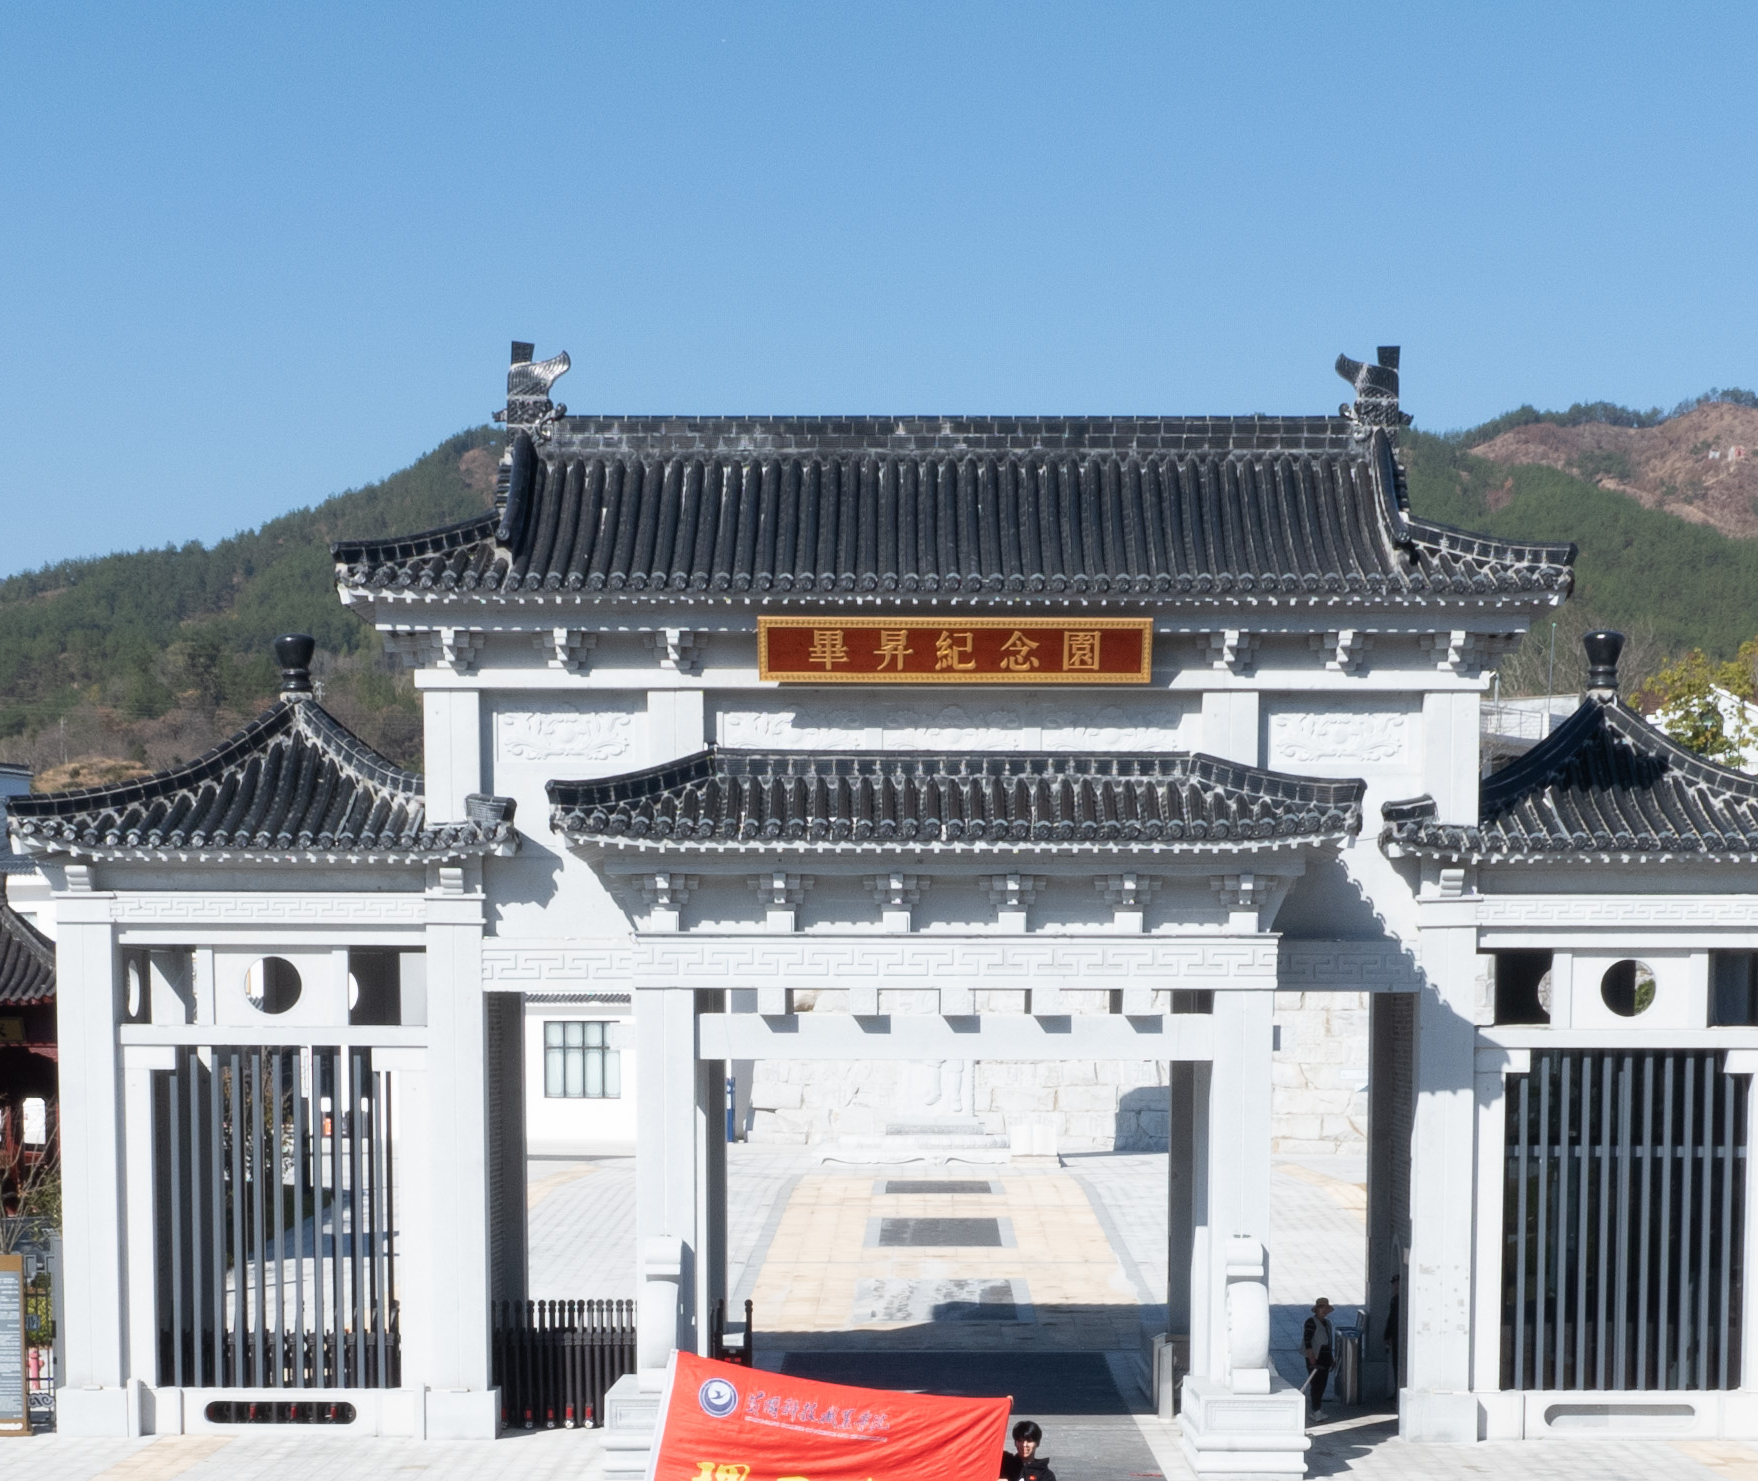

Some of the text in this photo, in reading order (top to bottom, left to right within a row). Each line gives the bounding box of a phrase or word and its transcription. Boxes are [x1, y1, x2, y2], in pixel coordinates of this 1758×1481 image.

[808, 629, 1102, 672] 畢昇紀念園
